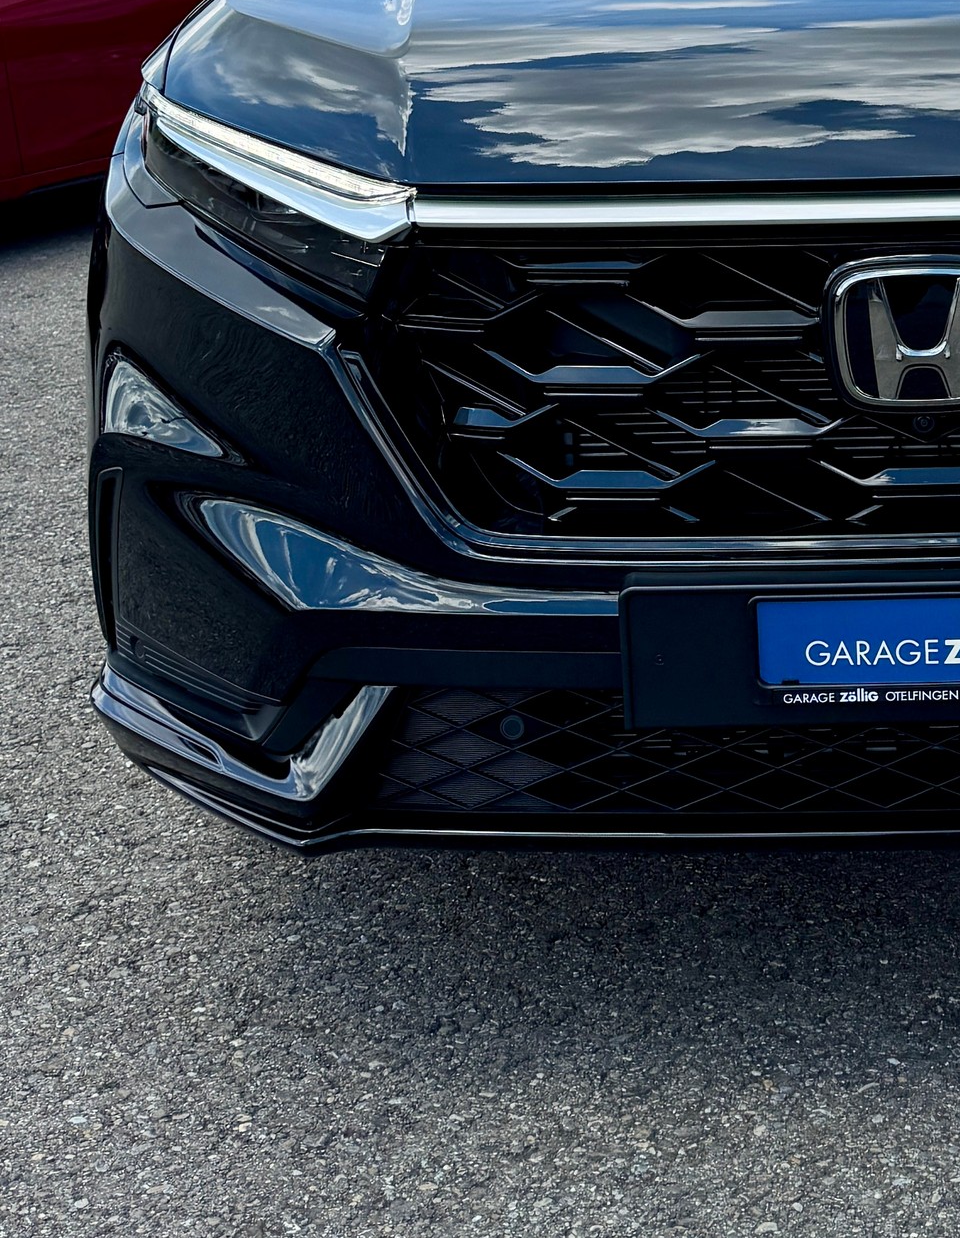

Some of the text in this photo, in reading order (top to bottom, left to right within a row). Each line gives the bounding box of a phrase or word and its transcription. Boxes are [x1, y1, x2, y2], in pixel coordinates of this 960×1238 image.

[805, 640, 938, 666] GARAGE
[783, 693, 835, 704] GARAGE
[885, 689, 959, 702] OTELFINGEN
